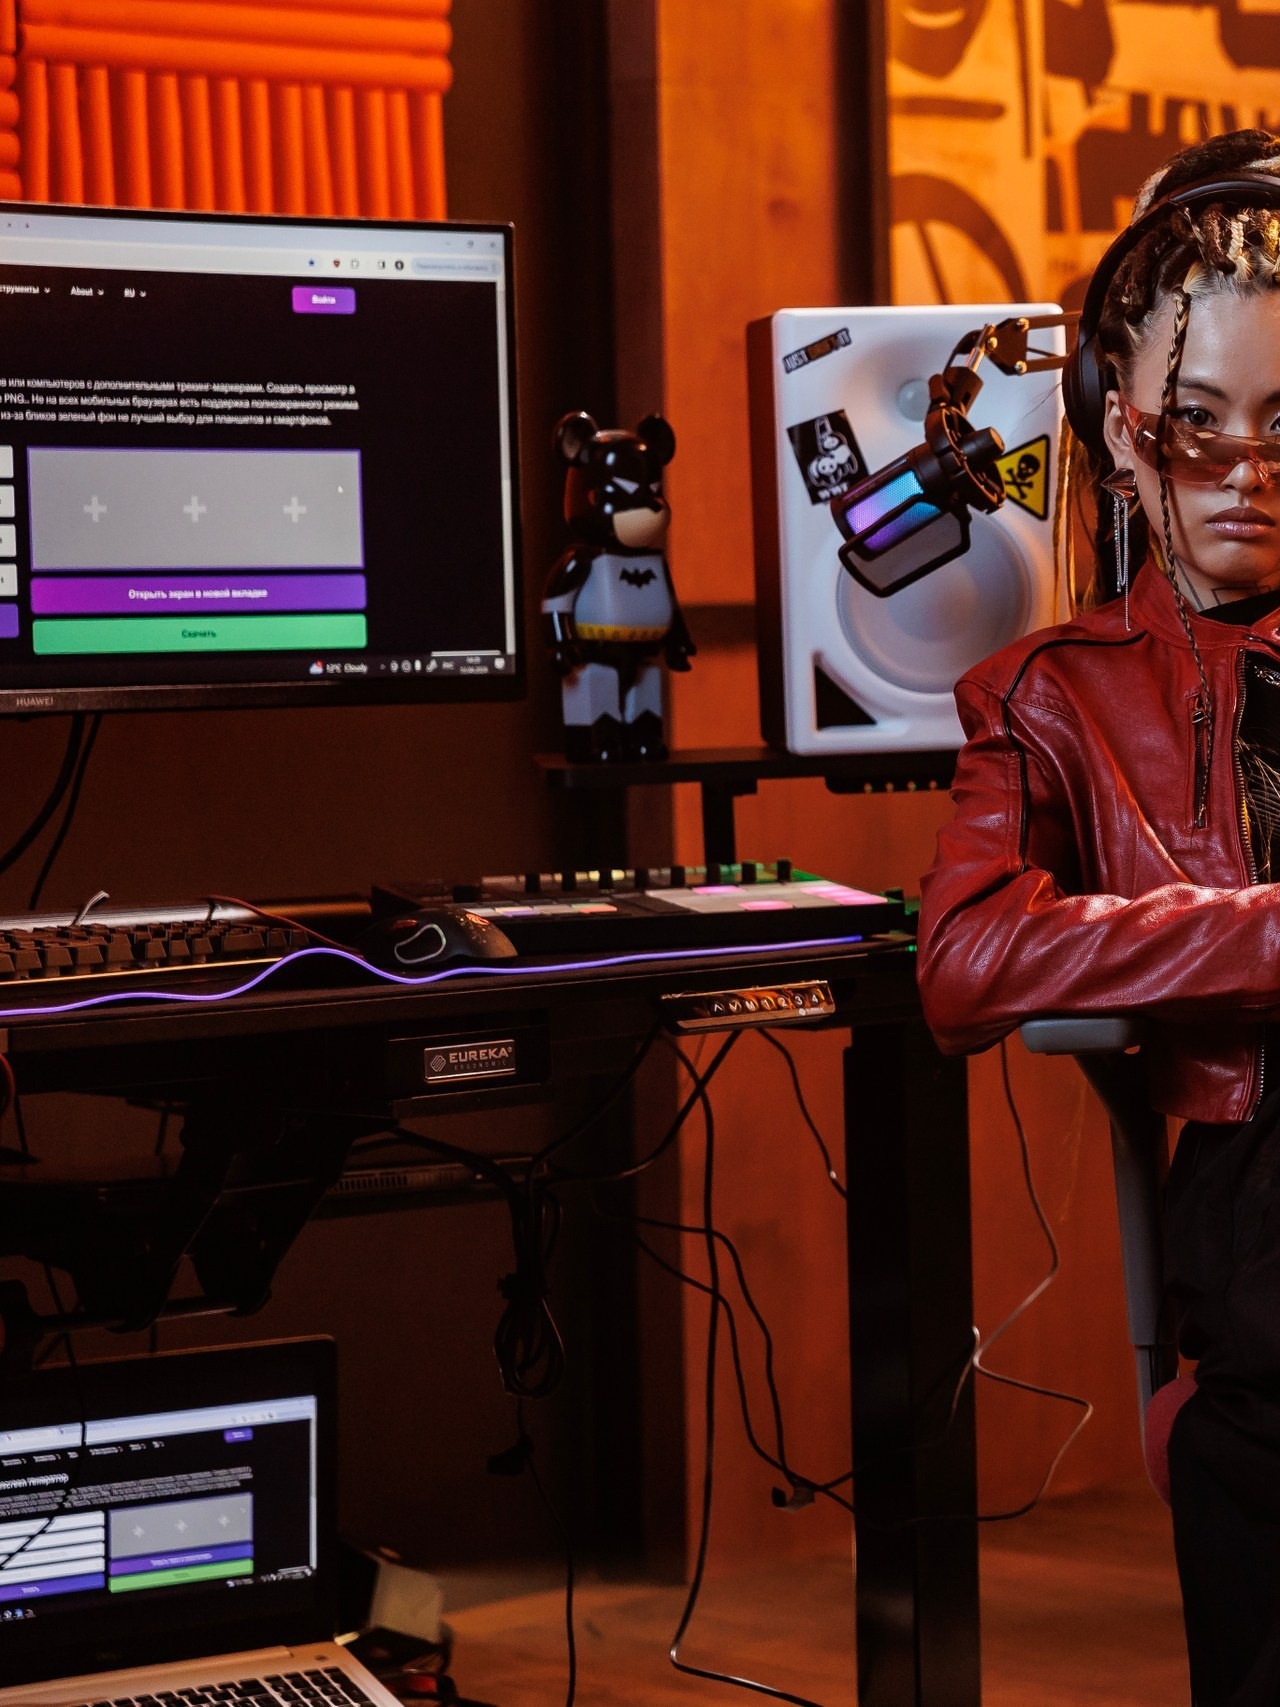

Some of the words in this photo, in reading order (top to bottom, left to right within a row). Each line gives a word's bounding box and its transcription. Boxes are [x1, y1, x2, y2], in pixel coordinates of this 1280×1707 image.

[70, 286, 93, 296] About
[9, 379, 26, 387] или
[27, 379, 86, 390] компьютеров
[59, 396, 79, 405] всех
[80, 395, 131, 406] мобильных
[132, 396, 178, 408] браузерах
[1, 412, 25, 420] из-за
[26, 410, 57, 421] бликов
[58, 411, 96, 421] зеленый
[98, 412, 116, 423] фон
[118, 414, 129, 422] не
[131, 413, 165, 424] лучший
[167, 413, 195, 425] выбор
[196, 415, 213, 424] для
[215, 415, 264, 424] планшетов
[128, 589, 168, 600] Открыть
[16, 696, 54, 706] HUAWEI
[795, 995, 803, 1006] 3
[811, 994, 819, 1003] 4
